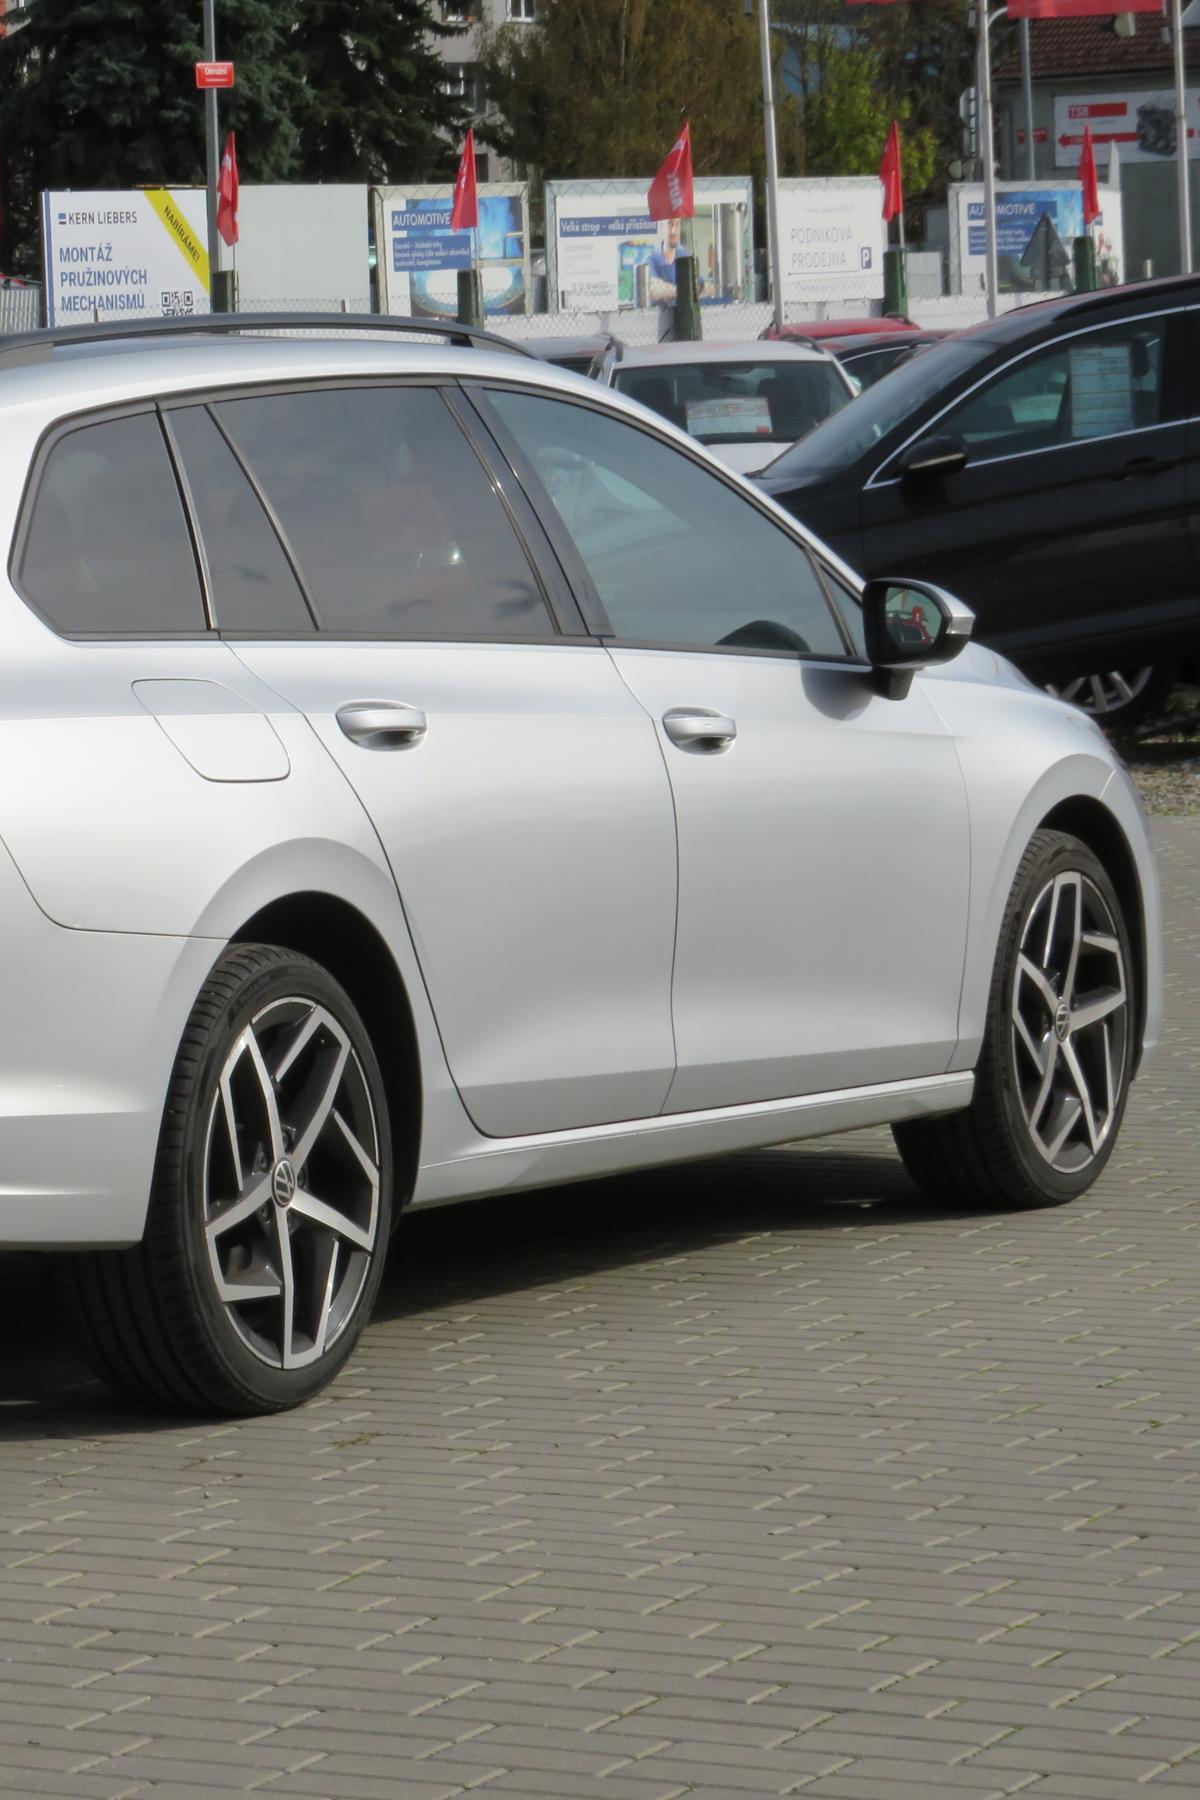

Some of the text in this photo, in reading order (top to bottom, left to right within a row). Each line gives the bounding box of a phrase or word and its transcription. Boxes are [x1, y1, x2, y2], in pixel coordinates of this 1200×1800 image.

[68, 210, 138, 225] KERN LIEBERS
[393, 211, 452, 226] AUTOMOTIVE
[969, 203, 1036, 216] AUMOTIVE
[163, 205, 201, 263] NABÍRÁME!
[560, 220, 580, 232] Velké
[581, 223, 601, 236] stroje
[607, 218, 624, 231] velká
[791, 222, 853, 244] PODNIKOVÁ
[59, 243, 113, 263] MONTÁŽ
[792, 251, 847, 268] PRODEJNA
[60, 266, 148, 288] PRUŽINOVÝCH
[61, 290, 146, 312] MECHANISMŮ
